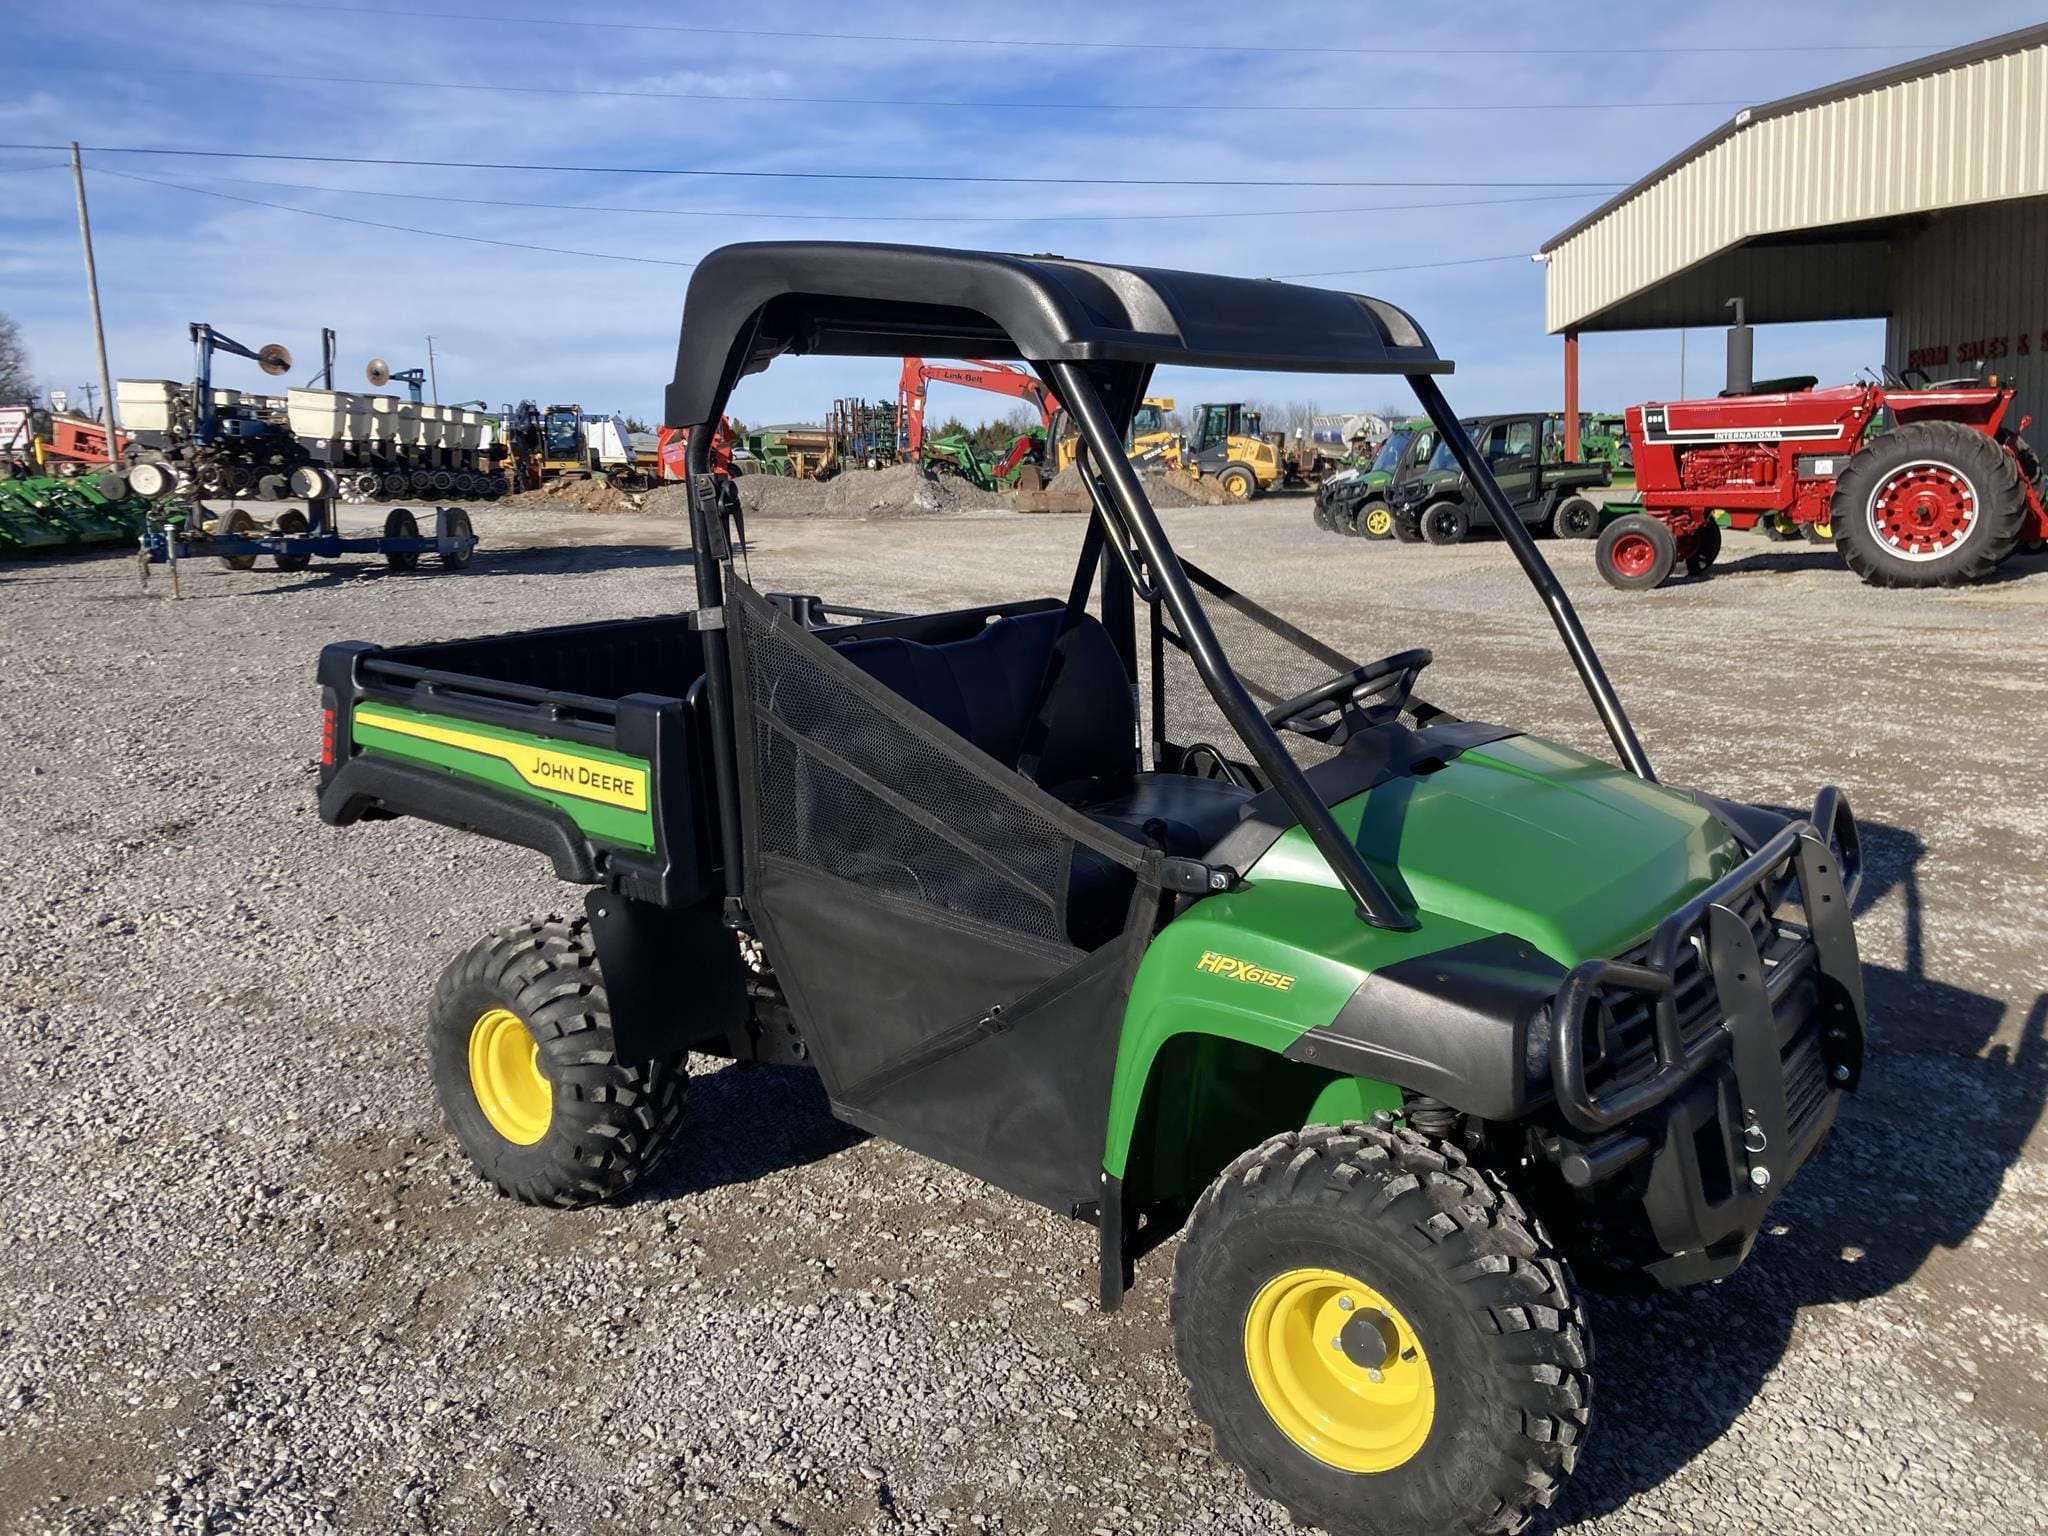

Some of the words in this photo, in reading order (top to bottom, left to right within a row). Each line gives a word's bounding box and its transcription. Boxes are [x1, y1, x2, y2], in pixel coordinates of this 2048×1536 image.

[1909, 346, 1948, 368] FARM
[1957, 337, 2008, 364] SALES
[2017, 333, 2030, 355] &
[944, 371, 983, 383] Link-Belt
[1714, 431, 1782, 440] INTERNATIONAL
[533, 757, 574, 782] JOHN
[579, 767, 634, 795] DEERE
[1196, 952, 1296, 990] HPX615E
